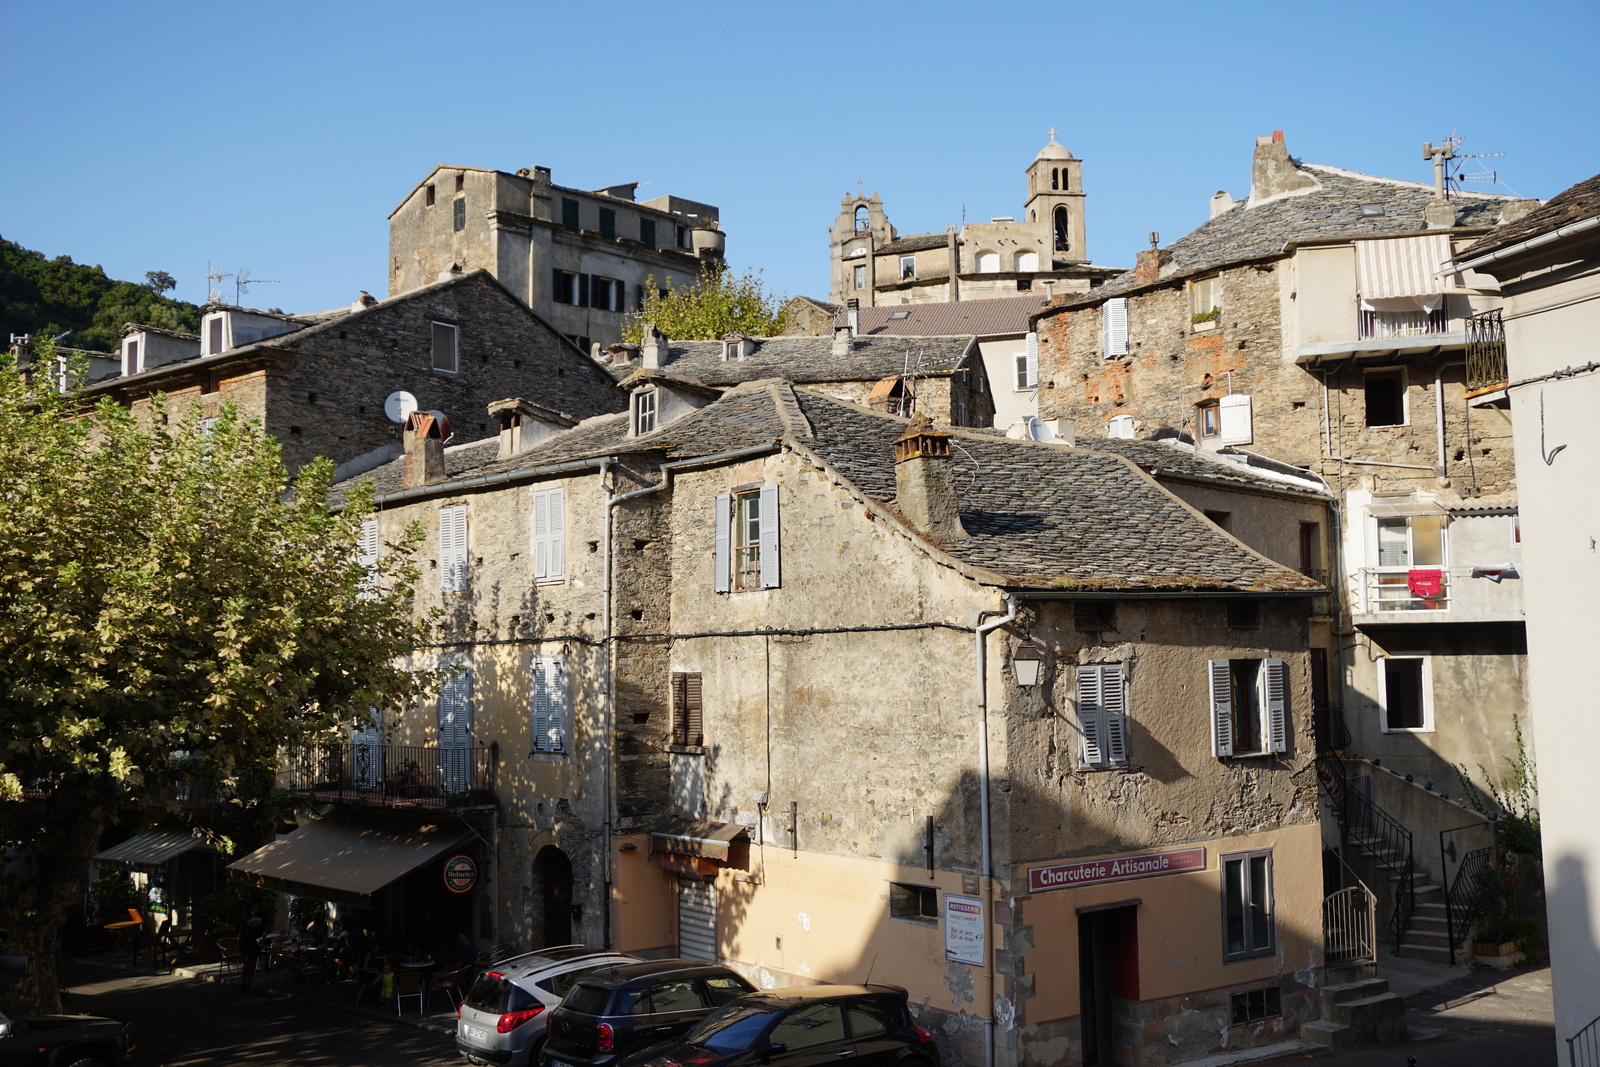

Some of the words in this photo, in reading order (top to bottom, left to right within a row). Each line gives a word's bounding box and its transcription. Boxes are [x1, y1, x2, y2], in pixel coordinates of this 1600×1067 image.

[1040, 863, 1106, 885] Charcuterie
[1111, 855, 1169, 875] Artisanale
[950, 903, 980, 913] ROTISSERIE
